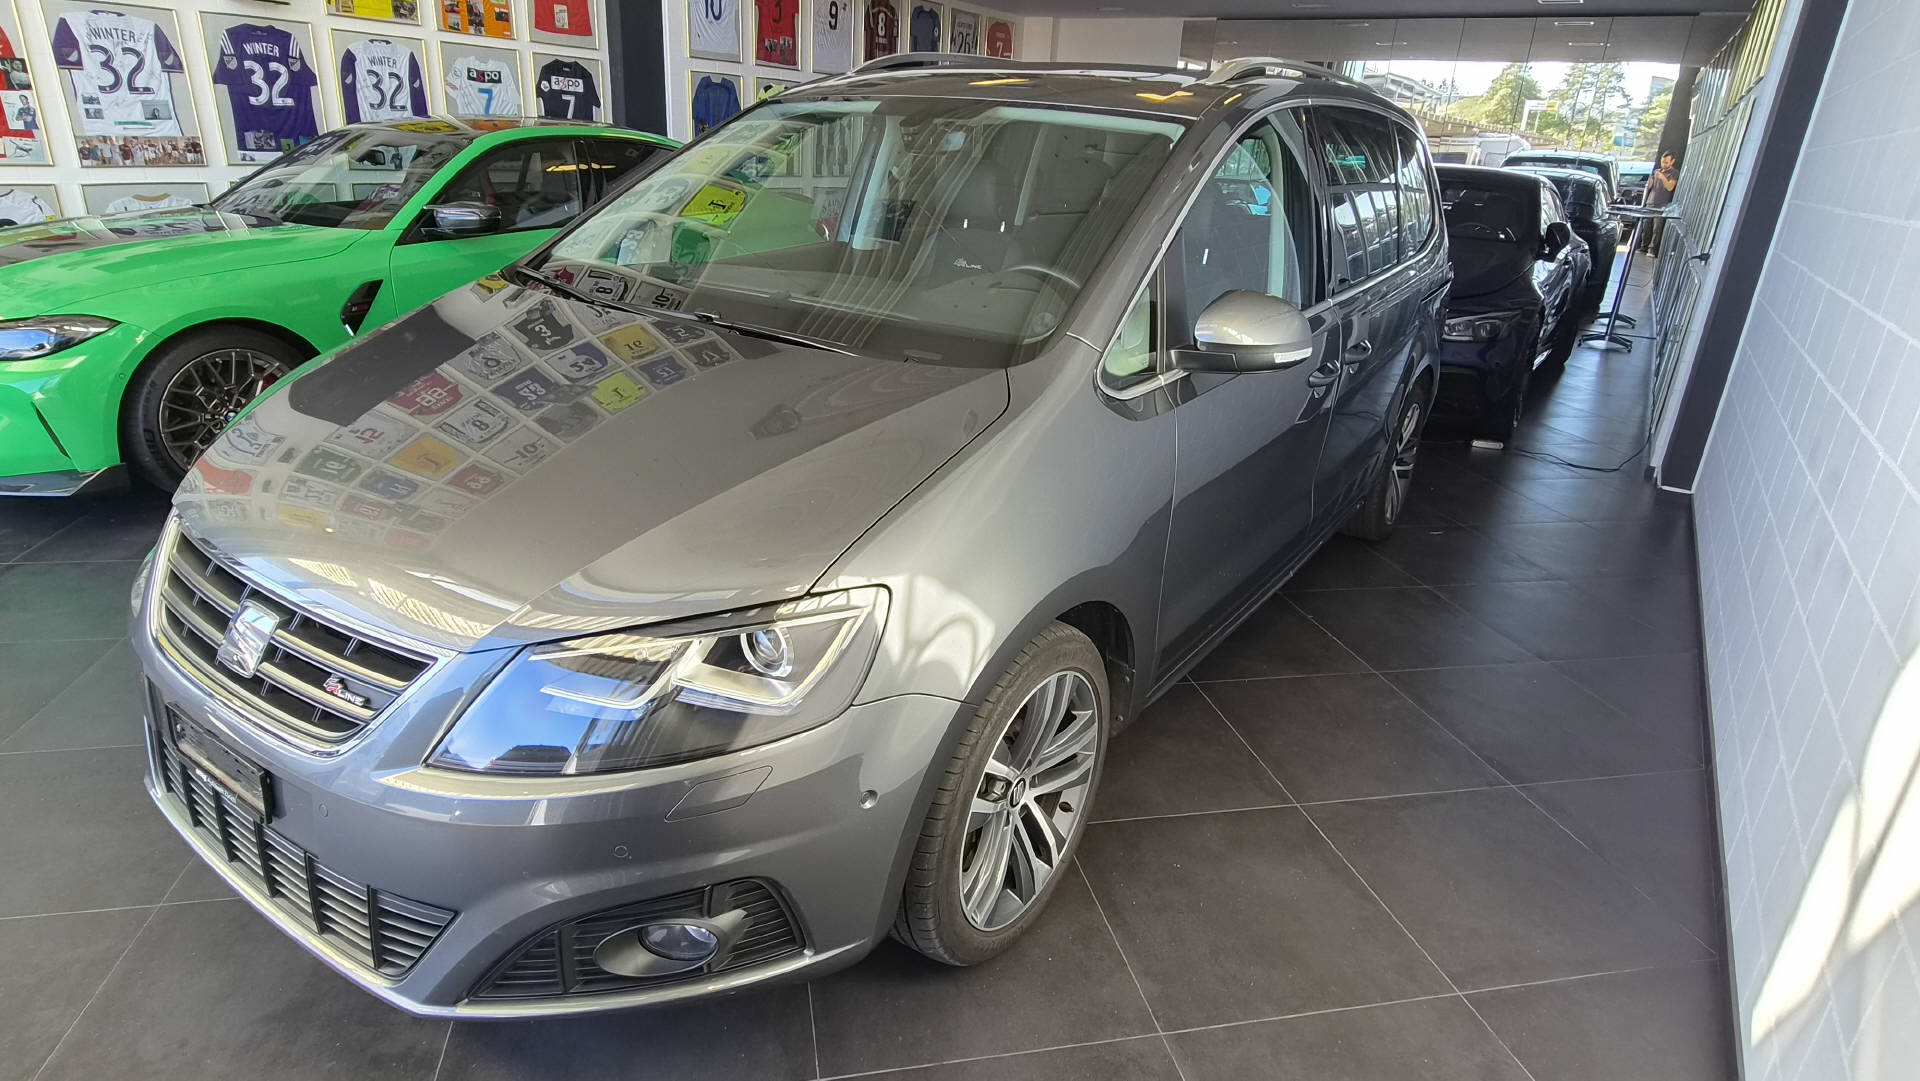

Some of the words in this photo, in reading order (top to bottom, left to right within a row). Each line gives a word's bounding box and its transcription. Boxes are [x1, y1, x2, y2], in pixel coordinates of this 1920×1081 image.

[828, 1, 839, 30] 9
[877, 12, 886, 36] 8
[89, 27, 137, 43] WINTER
[243, 42, 280, 57] WINTER
[367, 55, 398, 69] WINTER
[88, 44, 155, 95] 32
[243, 60, 295, 106] 32
[366, 69, 408, 111] 32
[478, 88, 494, 115] 7
[561, 94, 575, 119] 7
